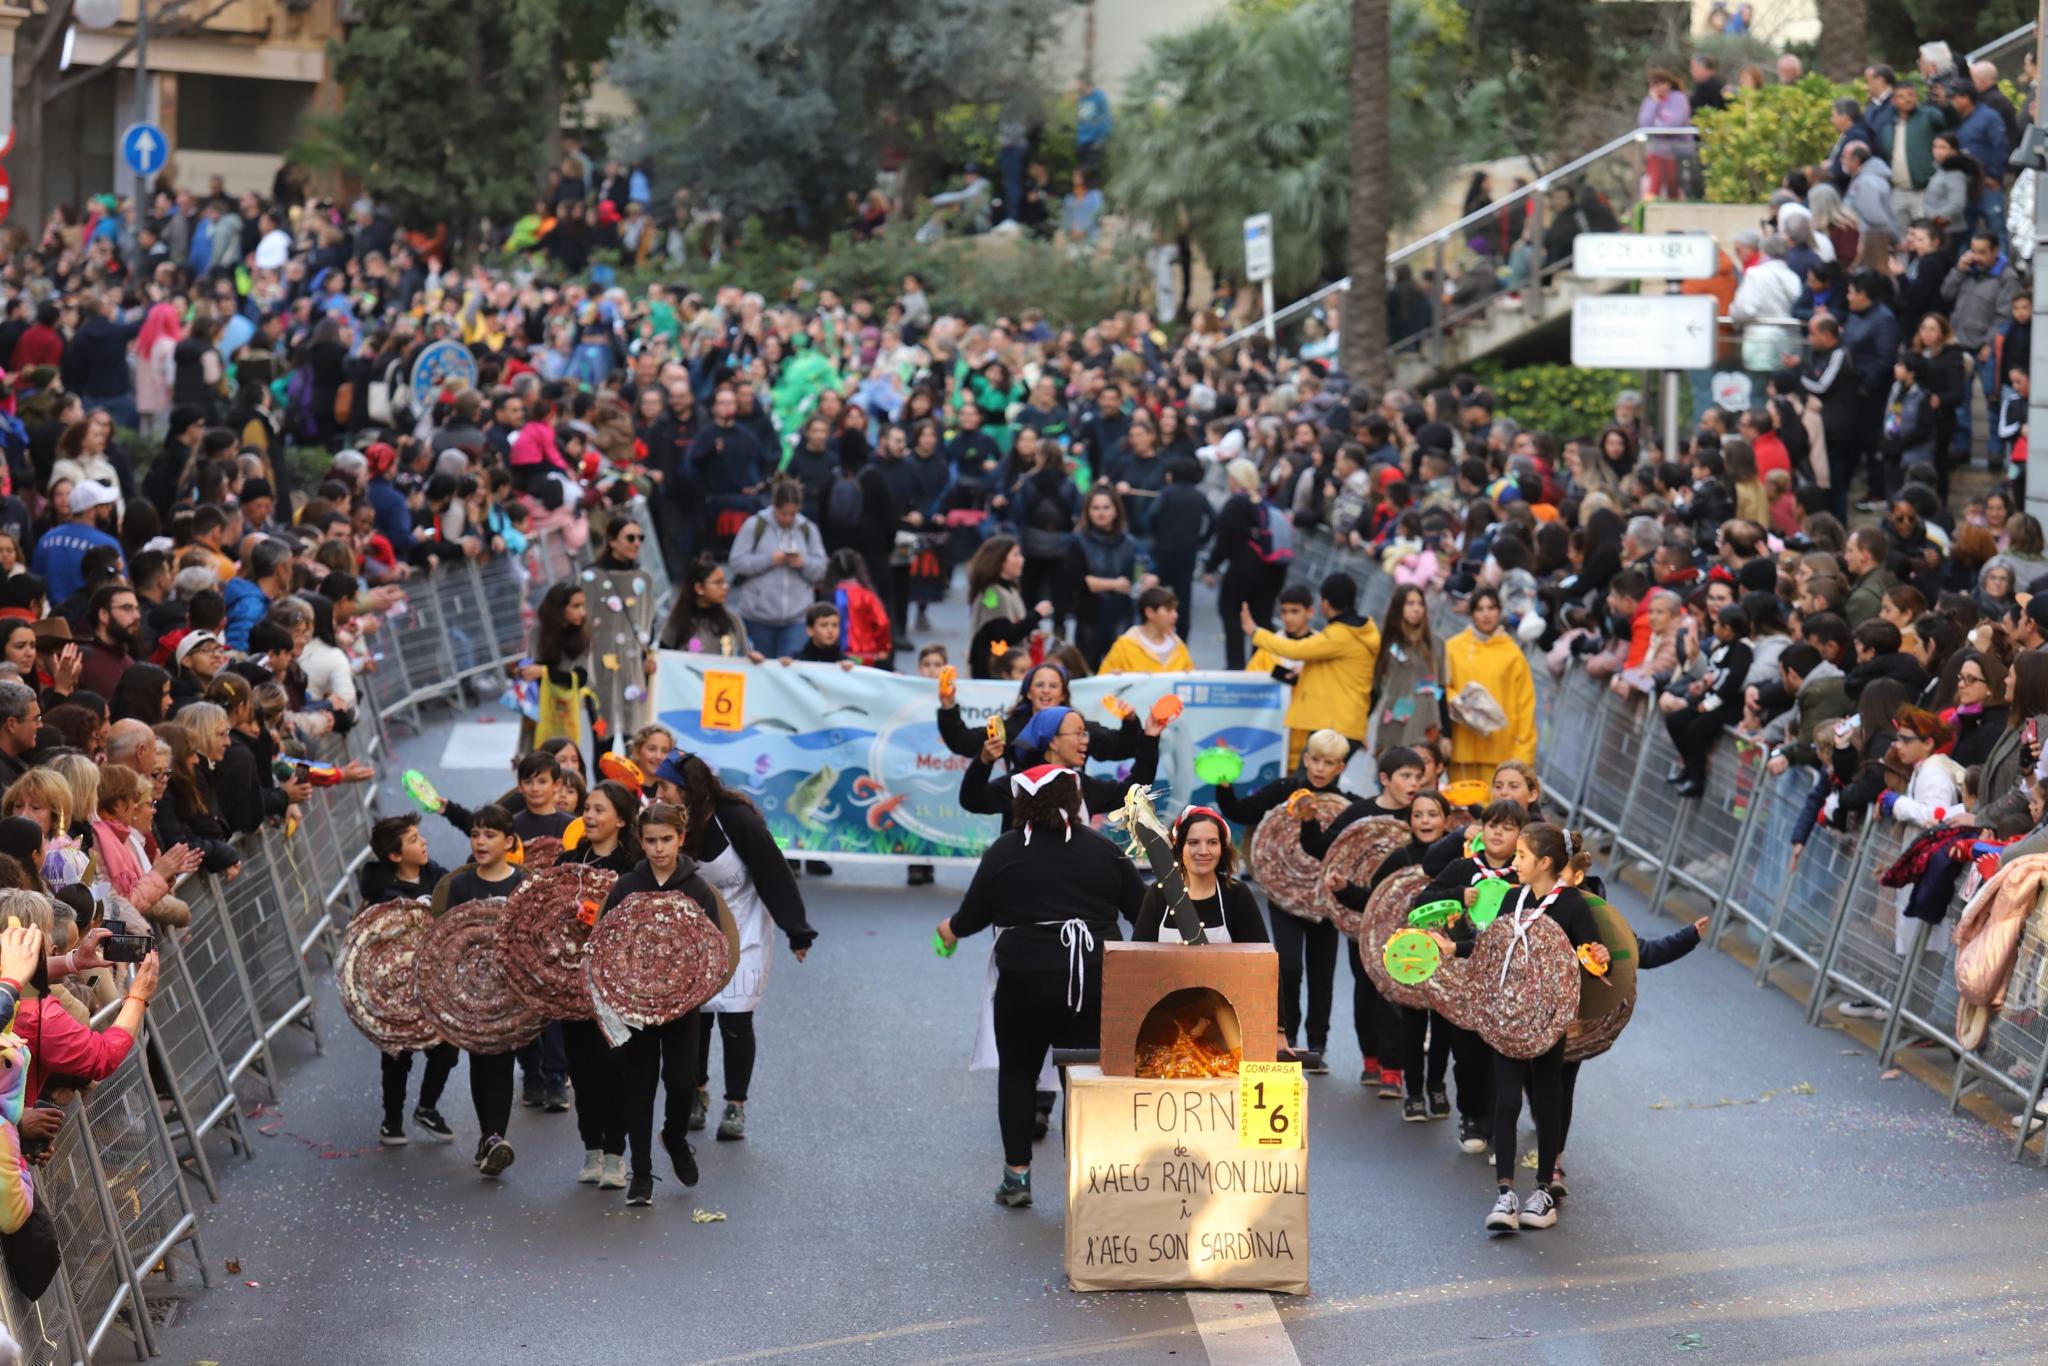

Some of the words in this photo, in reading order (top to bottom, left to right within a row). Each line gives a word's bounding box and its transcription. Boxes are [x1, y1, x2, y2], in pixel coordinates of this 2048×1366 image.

[715, 688, 732, 714] 6
[1245, 1064, 1296, 1074] COMPARSA
[1133, 1090, 1236, 1134] FORN
[1173, 1138, 1191, 1158] de
[1162, 1160, 1247, 1195] RAMON
[1252, 1160, 1307, 1195] LLULL
[1179, 1199, 1192, 1220] i
[1148, 1233, 1190, 1263] SON
